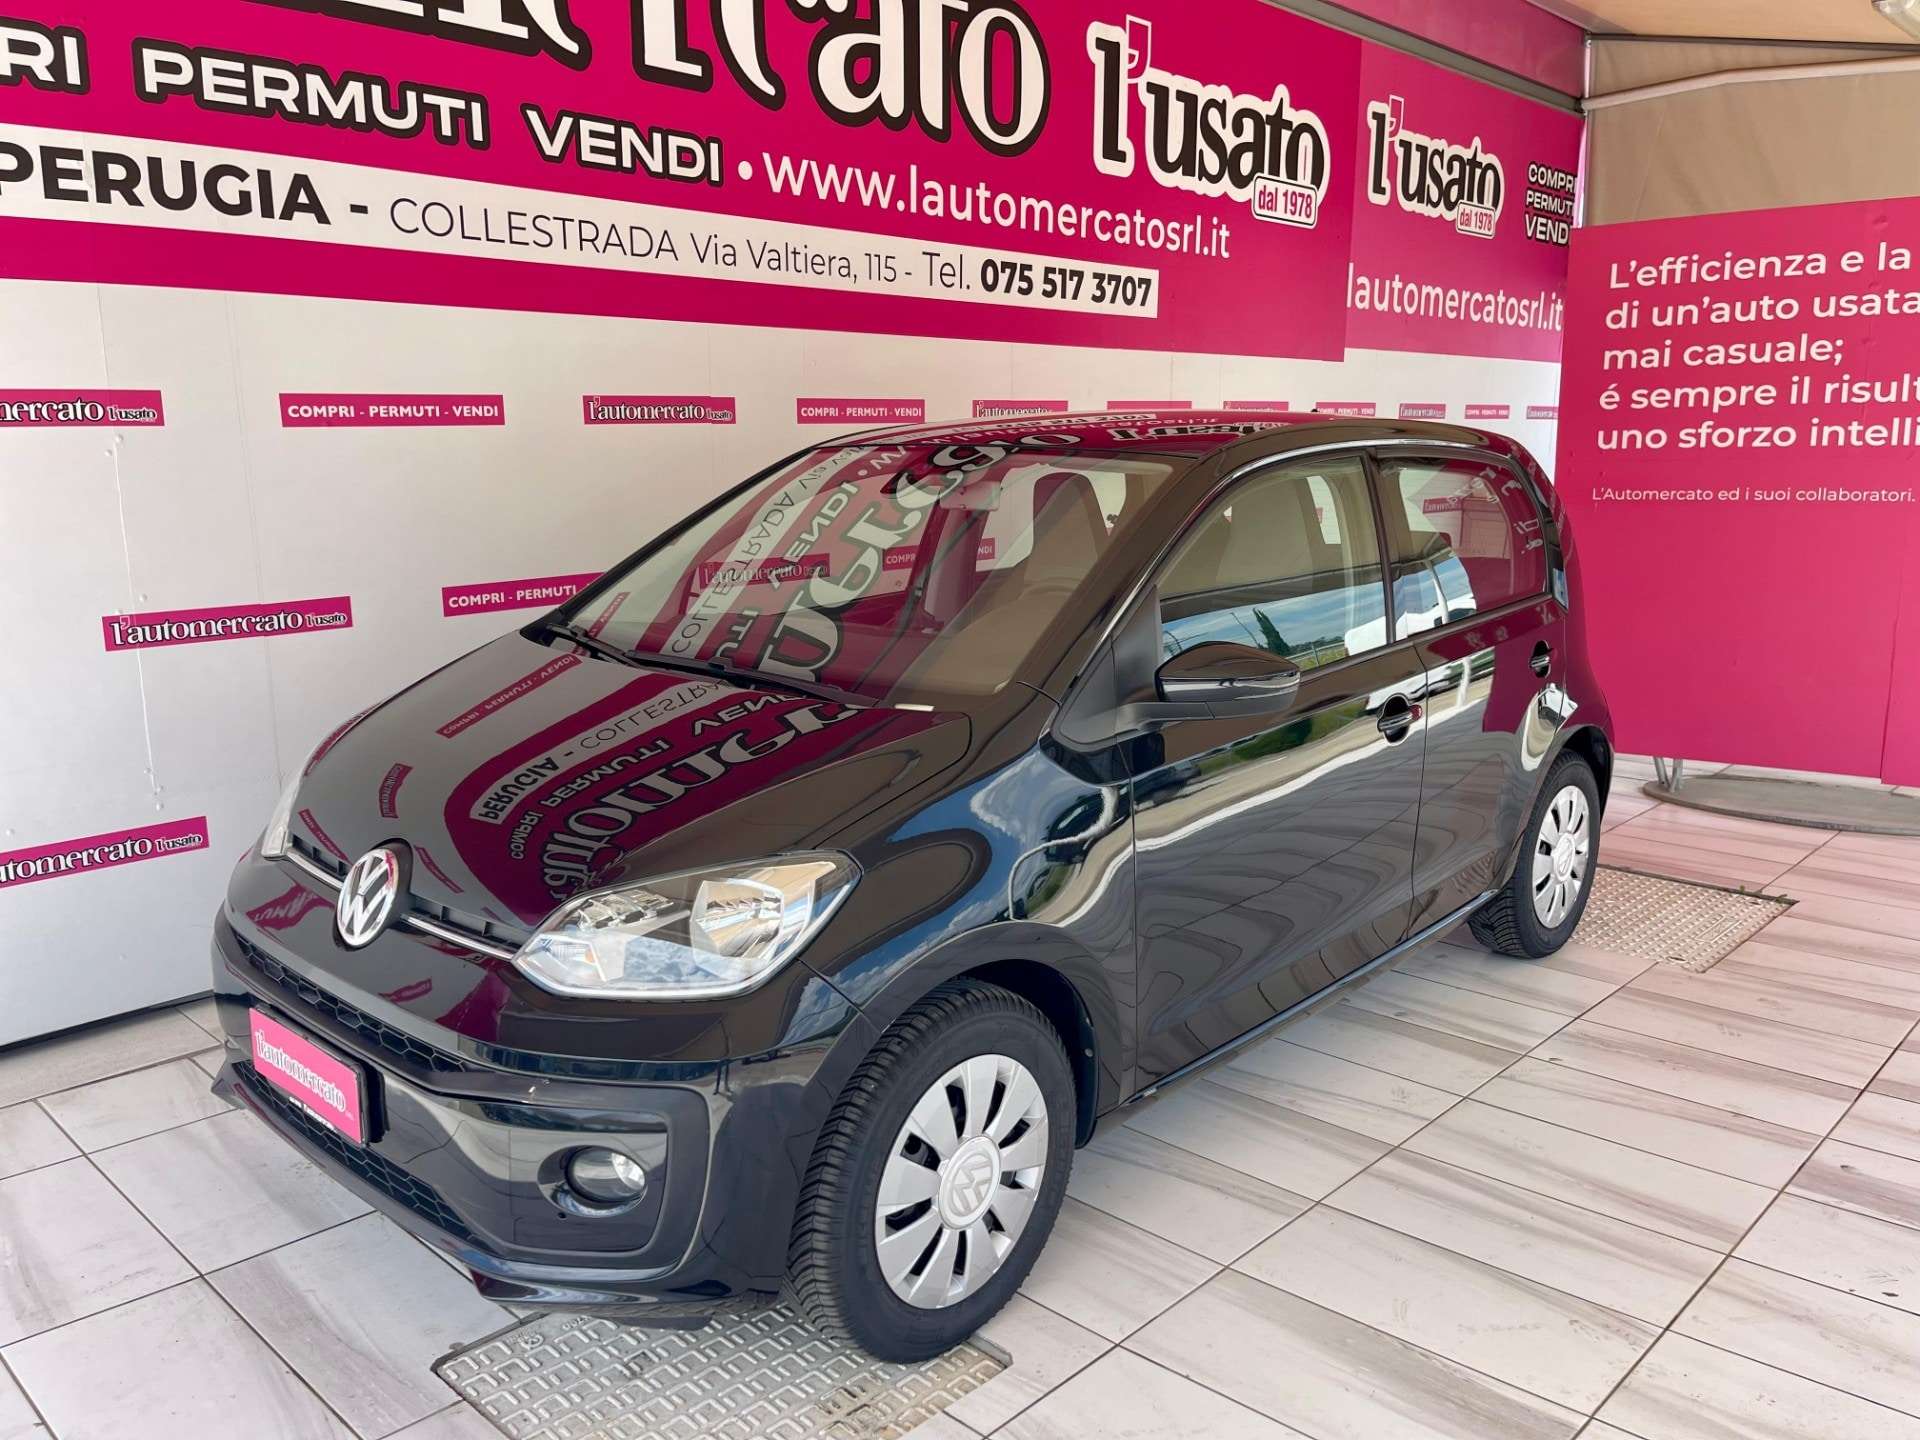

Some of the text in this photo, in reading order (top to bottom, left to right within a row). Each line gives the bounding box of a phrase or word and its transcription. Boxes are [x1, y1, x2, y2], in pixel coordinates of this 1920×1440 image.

[1092, 14, 1328, 194] l'usato
[141, 46, 486, 143] PERMUTI
[525, 108, 721, 182] VENDI
[762, 152, 1230, 259] www.lautomercatosrl.it
[1369, 95, 1503, 212] l'usato
[1258, 185, 1313, 219] dal 1978
[1525, 189, 1574, 216] PERMUT
[0, 141, 331, 225] PERUGIA
[389, 197, 679, 262] COLLESTRADA
[690, 232, 737, 267] Via
[746, 239, 858, 285] Valtiera,
[864, 253, 898, 283] 115
[922, 251, 971, 292] Tel.
[980, 257, 1034, 296] 075
[1041, 262, 1084, 303] 517
[1091, 267, 1153, 308] 3707
[1459, 208, 1493, 233] dal 1978
[1525, 213, 1570, 245] VEND
[1609, 241, 1911, 289] L'efficienza e la
[1346, 262, 1563, 331] lautomercatosrl.it
[1605, 289, 1920, 330] di un'auto usata
[1603, 333, 1844, 370] mai casuale;
[588, 396, 706, 421] l'automercato
[1599, 373, 1920, 413] é sempre il risult
[287, 405, 355, 418] COMPRI
[369, 405, 440, 418] PERMUTI
[452, 405, 499, 418] VENDI
[800, 407, 839, 417] COMPRI
[846, 407, 888, 417] PERMUTI
[894, 407, 922, 417] VENDI
[1597, 416, 1920, 450] uno sforzo intelli
[1592, 487, 1916, 502] L'Automercato ed i suoi collaboratori.
[886, 554, 916, 565] COMPR
[448, 591, 505, 608] COMPRI
[516, 584, 578, 601] PERMUTI
